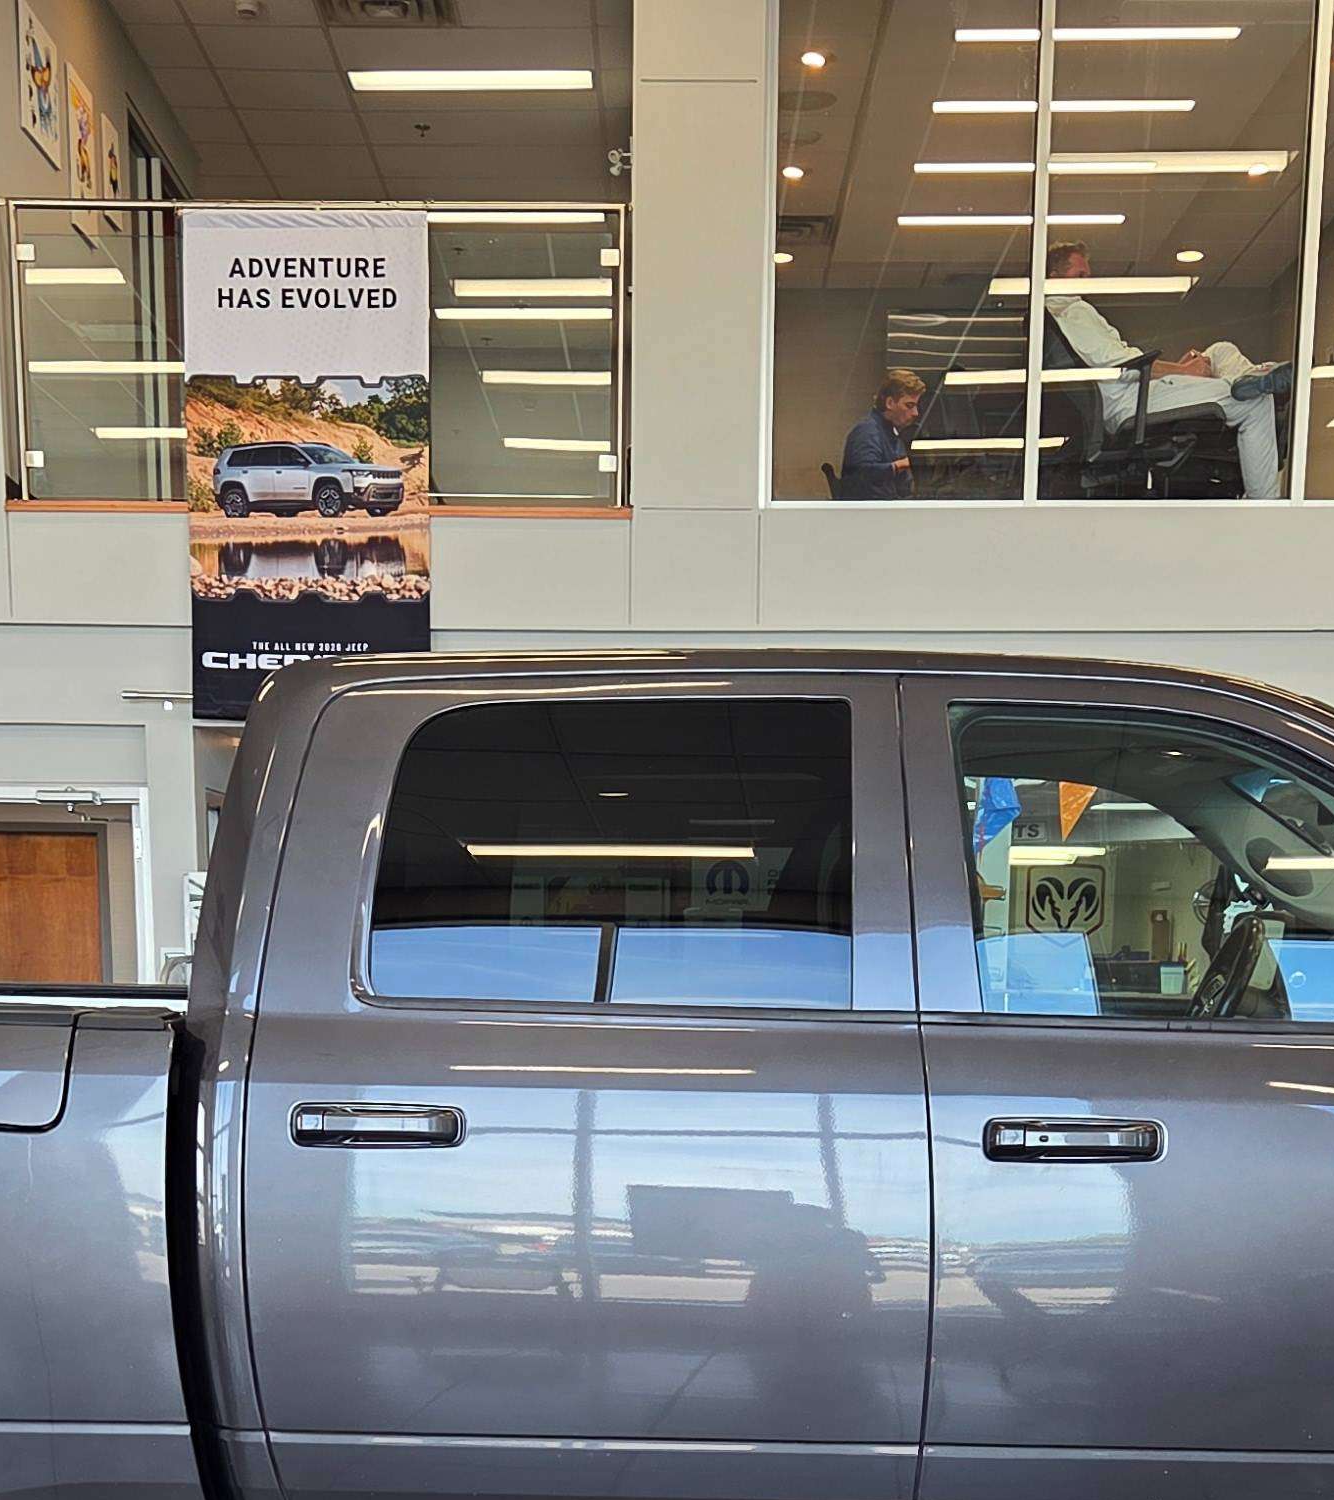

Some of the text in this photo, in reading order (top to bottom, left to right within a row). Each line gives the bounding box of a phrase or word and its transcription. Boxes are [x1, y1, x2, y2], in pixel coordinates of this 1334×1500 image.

[229, 257, 386, 278] ADVENTURE
[217, 288, 398, 309] HAS EVOLVED
[252, 641, 270, 651] THE
[274, 642, 290, 652] ALL
[294, 642, 315, 652] NEW
[345, 643, 370, 652] JEEP
